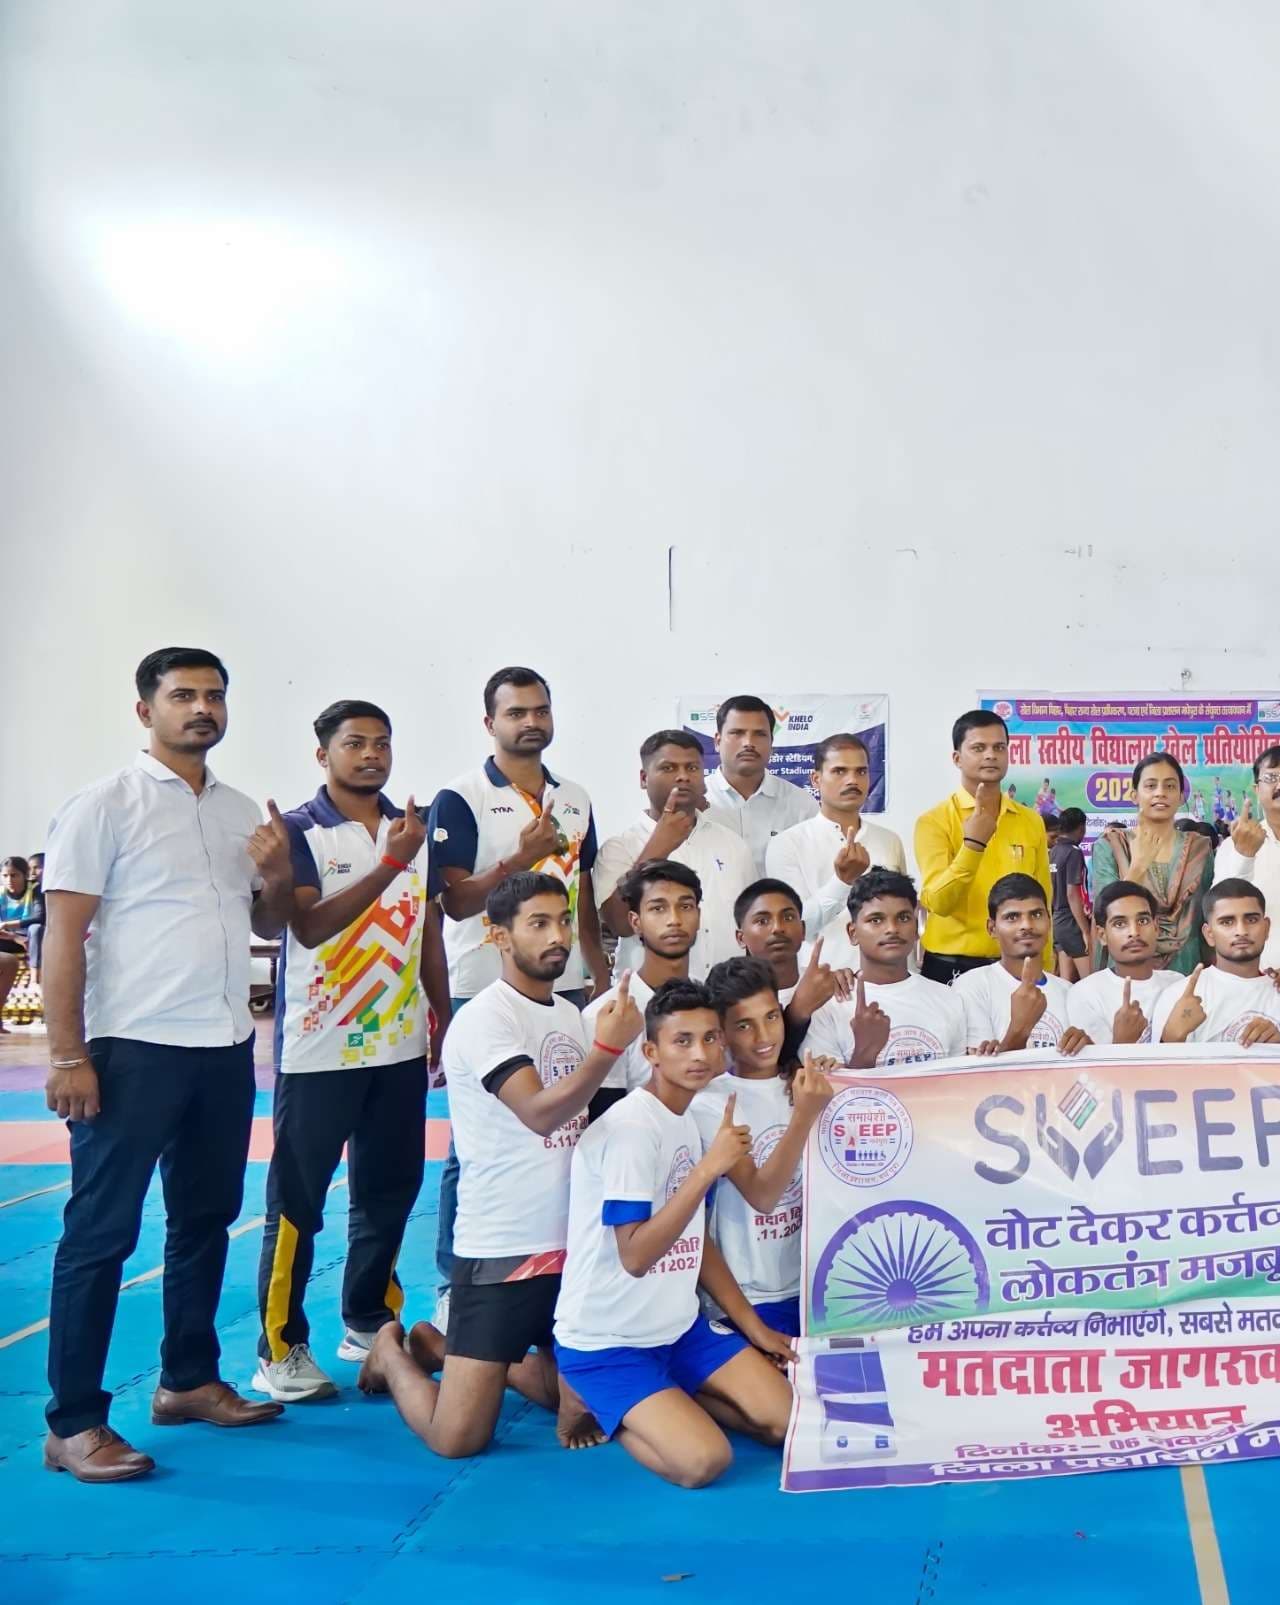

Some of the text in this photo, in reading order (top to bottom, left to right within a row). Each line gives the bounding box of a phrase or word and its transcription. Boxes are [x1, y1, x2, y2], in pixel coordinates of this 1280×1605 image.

[787, 723, 809, 731] INDIA
[788, 715, 813, 723] KHELO
[1008, 734, 1031, 765] ला
[1037, 726, 1085, 765] स्तरीय
[1090, 726, 1157, 765] विद्यालय
[1162, 725, 1198, 765] खेल
[1095, 777, 1134, 802] 202
[888, 1053, 931, 1066] SEEP
[845, 1109, 888, 1123] समावेशी
[754, 1214, 788, 1226] तदान
[985, 1208, 1062, 1250] वोट
[1067, 1205, 1173, 1245] देकर
[1000, 1250, 1170, 1301] लोकतंत्र
[907, 1320, 944, 1344] हम
[947, 1320, 1011, 1341] अपना
[1083, 1308, 1173, 1337] निभाएंगे,
[1179, 1302, 1233, 1335] सबसे
[917, 1349, 1107, 1397] मतदाता
[1045, 1398, 1247, 1440] अभियान
[929, 1459, 1056, 1476] जिला
[1062, 1435, 1240, 1470] प्रशासन
[1109, 1437, 1140, 1451] 06
